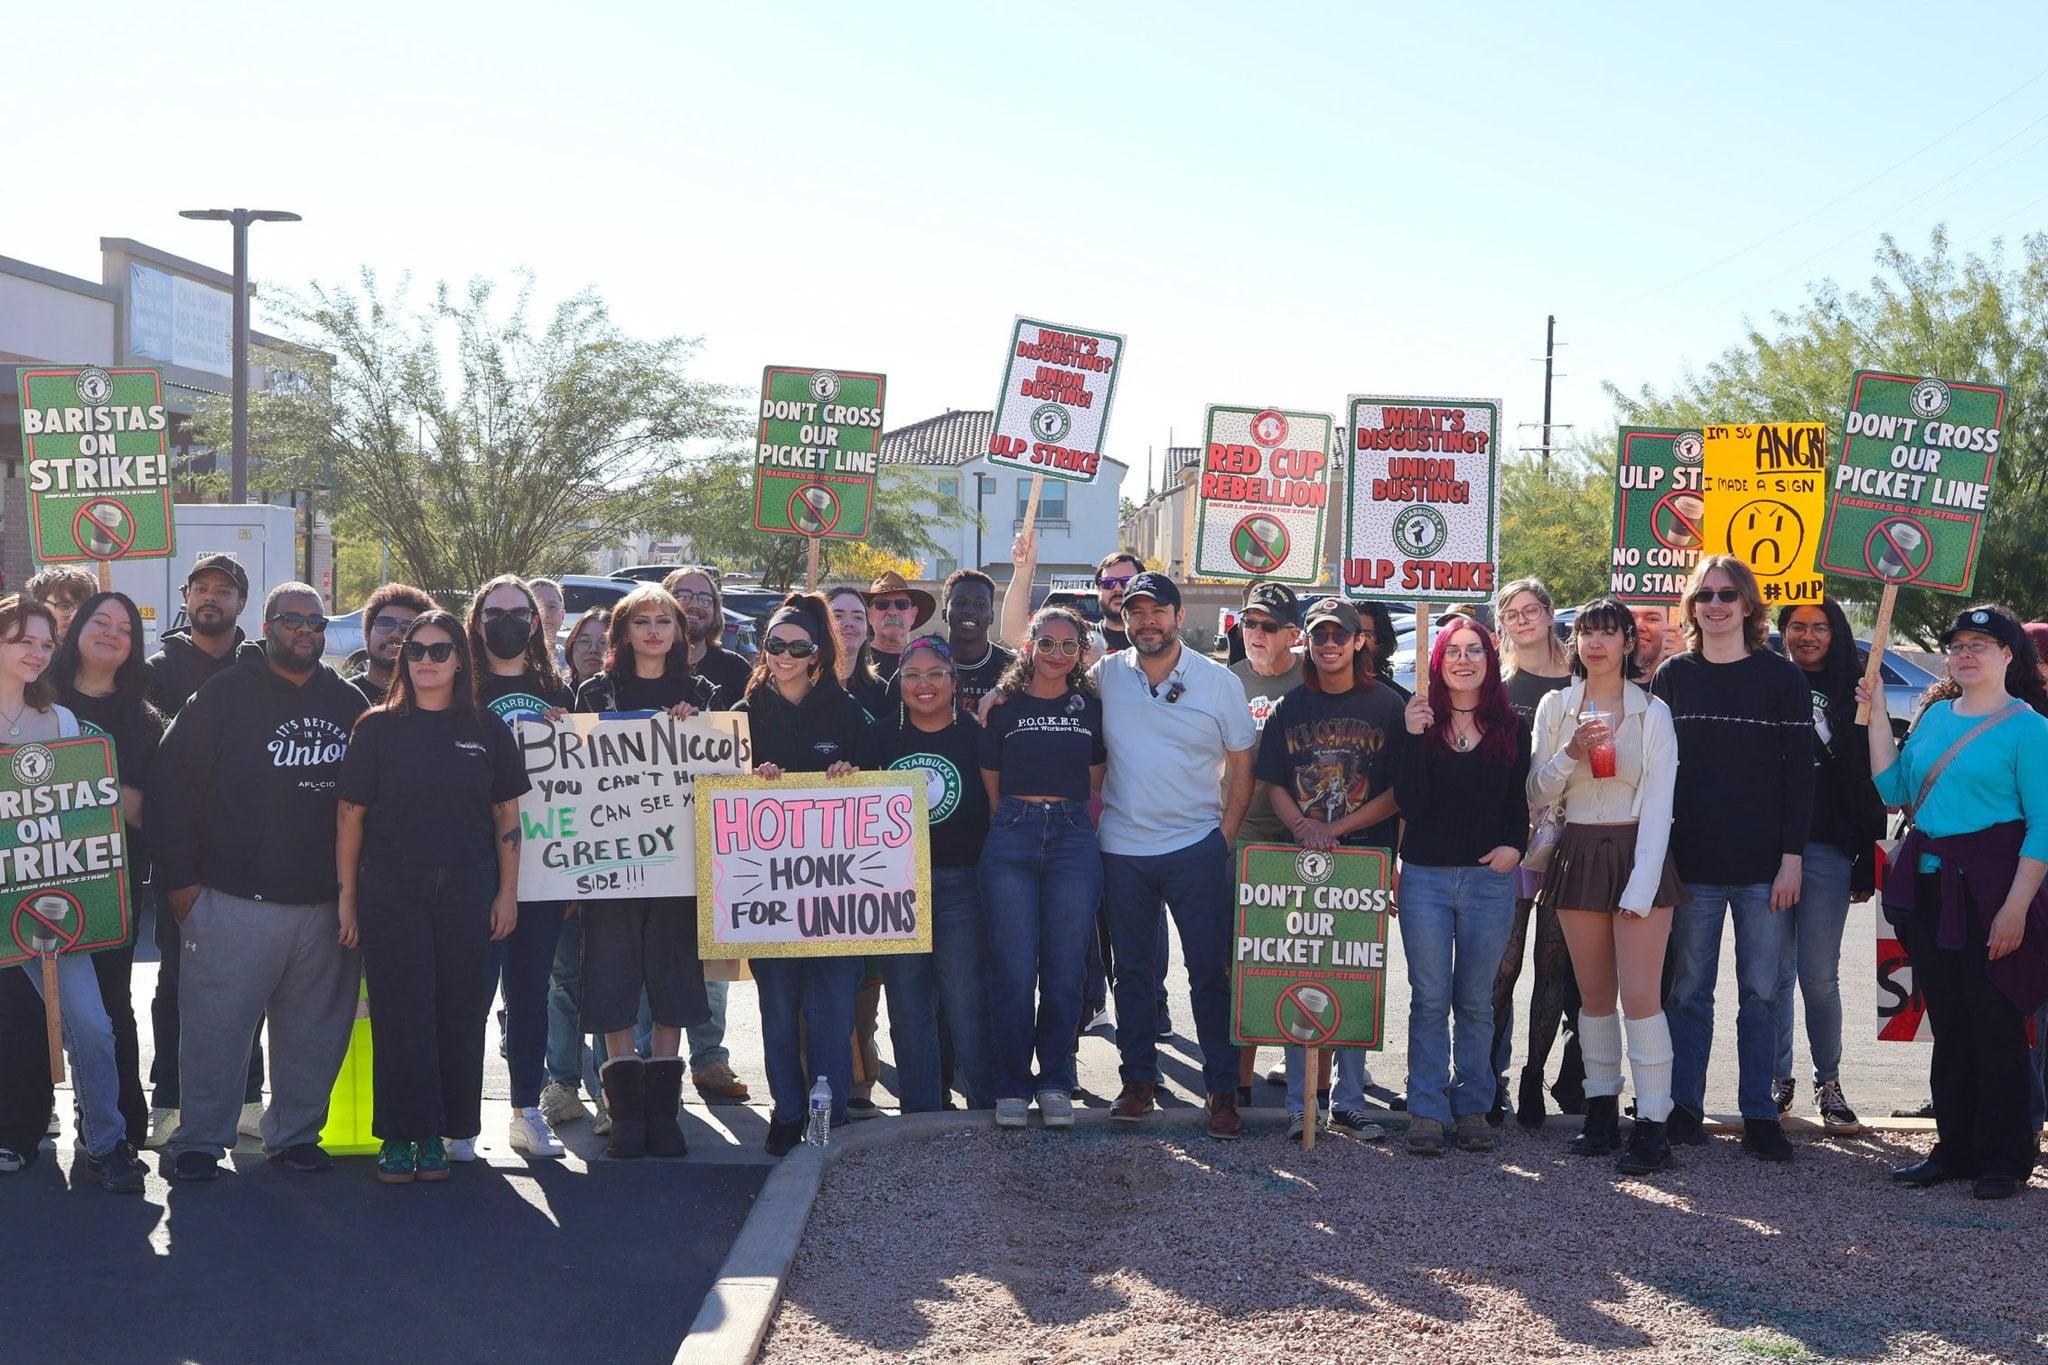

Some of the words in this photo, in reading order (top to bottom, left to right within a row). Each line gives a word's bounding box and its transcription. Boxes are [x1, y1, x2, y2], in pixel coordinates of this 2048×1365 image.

[1038, 328, 1099, 355] WHAT'S
[1016, 341, 1113, 373] DISGUSTING?
[1035, 366, 1085, 390] UNION
[1021, 379, 1093, 408] BUSTING!
[24, 406, 166, 433] BARISTAS
[762, 399, 818, 422] DON'T
[822, 404, 882, 428] CROSS
[1382, 407, 1465, 432] WHAT'S
[79, 434, 116, 455] ON
[800, 425, 839, 447] OUR
[1358, 428, 1488, 453] DISGUSTING?
[1707, 427, 1729, 440] IM
[1736, 427, 1752, 439] SO
[1846, 411, 1918, 442] DON'T
[1924, 422, 2000, 453] CROSS
[758, 443, 829, 470] PICKET
[835, 450, 878, 474] LINE
[989, 434, 1028, 459] ULP
[1030, 443, 1100, 475] STRIKE
[1208, 443, 1262, 475] RED
[1270, 448, 1326, 480] CUP
[1890, 446, 1941, 473] OUR
[30, 455, 167, 491] STRIKE!
[764, 469, 806, 480] BARISTAS
[1388, 457, 1455, 481] UNION
[1620, 465, 1664, 489] ULP
[1672, 467, 1704, 490] ST
[1201, 473, 1327, 508] REBELLION
[1372, 479, 1470, 504] BUSTING!
[1704, 477, 1712, 491] I
[1718, 477, 1748, 492] MADE
[1757, 479, 1766, 491] A
[1776, 479, 1814, 493] SIGN
[1835, 464, 1926, 501] PICKET
[1931, 478, 1990, 511] LINE
[1258, 504, 1291, 514] PRACTICE
[1292, 508, 1317, 516] STRIKE
[1401, 509, 1440, 523] STARBUCKS
[1842, 498, 1893, 511] BARISTAS
[1894, 504, 1910, 514] ON
[1910, 507, 1932, 517] ULP
[1932, 510, 1973, 523] STRIKE
[1397, 530, 1420, 554] WORKERS
[1426, 531, 1442, 552] UNITED
[1613, 548, 1640, 566] NO
[1646, 549, 1704, 567] CONT
[1344, 558, 1395, 588] ULP
[1402, 560, 1495, 591] STRIKE
[1611, 573, 1636, 593] NO
[1642, 573, 1692, 593] STAR
[495, 698, 546, 716] TARBUC
[276, 719, 299, 738] IT'S
[303, 717, 347, 741] BETTER
[1018, 716, 1080, 728] P.O.C.K.E.T.
[518, 718, 646, 774] BRIAN
[900, 757, 954, 779] STARBUCKS
[0, 777, 118, 819] RISTAS
[538, 779, 582, 801] YOU
[598, 771, 664, 792] CAN'T
[17, 815, 61, 843] ON
[520, 807, 578, 840] WE
[590, 804, 631, 827] CAN
[640, 794, 674, 814] SEE
[714, 794, 912, 854] HOTTIES
[0, 833, 122, 884] TRIKE!
[542, 825, 674, 868] GREEDY
[10, 884, 38, 893] LABOR
[39, 877, 80, 888] PRACTICE
[80, 873, 110, 882] STRIKE
[770, 854, 856, 891] HONK
[1239, 883, 1306, 908] DON'T
[1314, 886, 1387, 912] CROSS
[731, 901, 793, 929] FOR
[798, 889, 916, 938] UNIONS
[1286, 911, 1335, 937] OUR
[1237, 936, 1324, 965] PICKET
[1331, 940, 1384, 968] LINE
[1246, 968, 1297, 978] BARISTAS
[1297, 969, 1313, 979] ON
[1335, 971, 1374, 981] STRIKE
